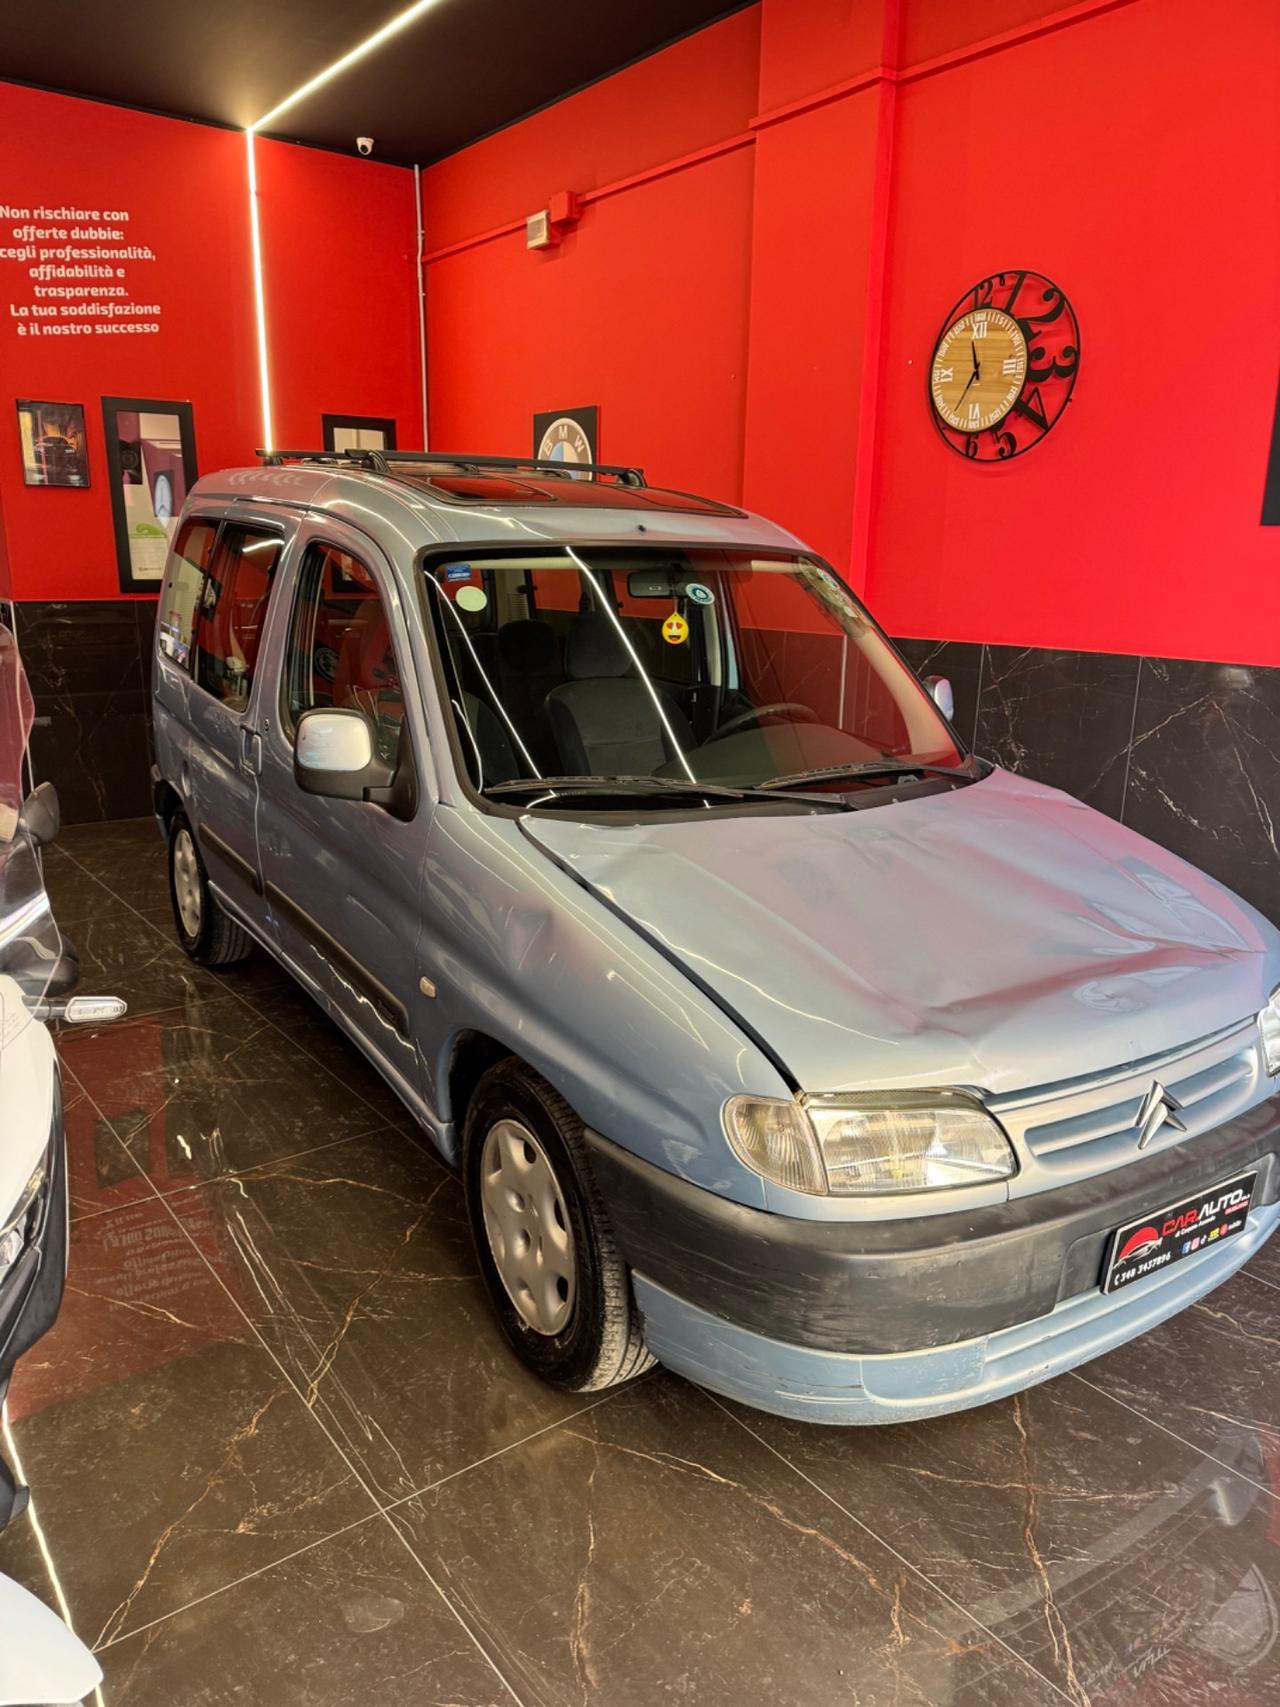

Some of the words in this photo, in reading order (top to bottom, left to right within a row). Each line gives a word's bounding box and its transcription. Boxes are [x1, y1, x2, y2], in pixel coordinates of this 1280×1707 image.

[0, 205, 30, 219] Non
[33, 206, 101, 221] rischiare
[103, 210, 129, 221] con
[13, 226, 67, 241] offerte
[71, 227, 124, 240] dubbie:
[40, 245, 156, 261] professionalità,
[29, 265, 113, 280] affidabilità
[116, 268, 125, 277] e
[34, 285, 128, 299] trasparenza.
[972, 278, 993, 309] 12
[10, 304, 29, 316] La
[31, 304, 57, 316] tua
[60, 302, 161, 317] soddisfazione
[17, 323, 27, 335] è
[30, 323, 40, 335] il
[43, 323, 92, 335] nostro
[95, 323, 159, 334] successo
[971, 322, 988, 340] XII
[1028, 345, 1078, 383] 3
[1014, 386, 1050, 432] 4
[965, 433, 979, 458] 6
[993, 419, 1018, 459] 5
